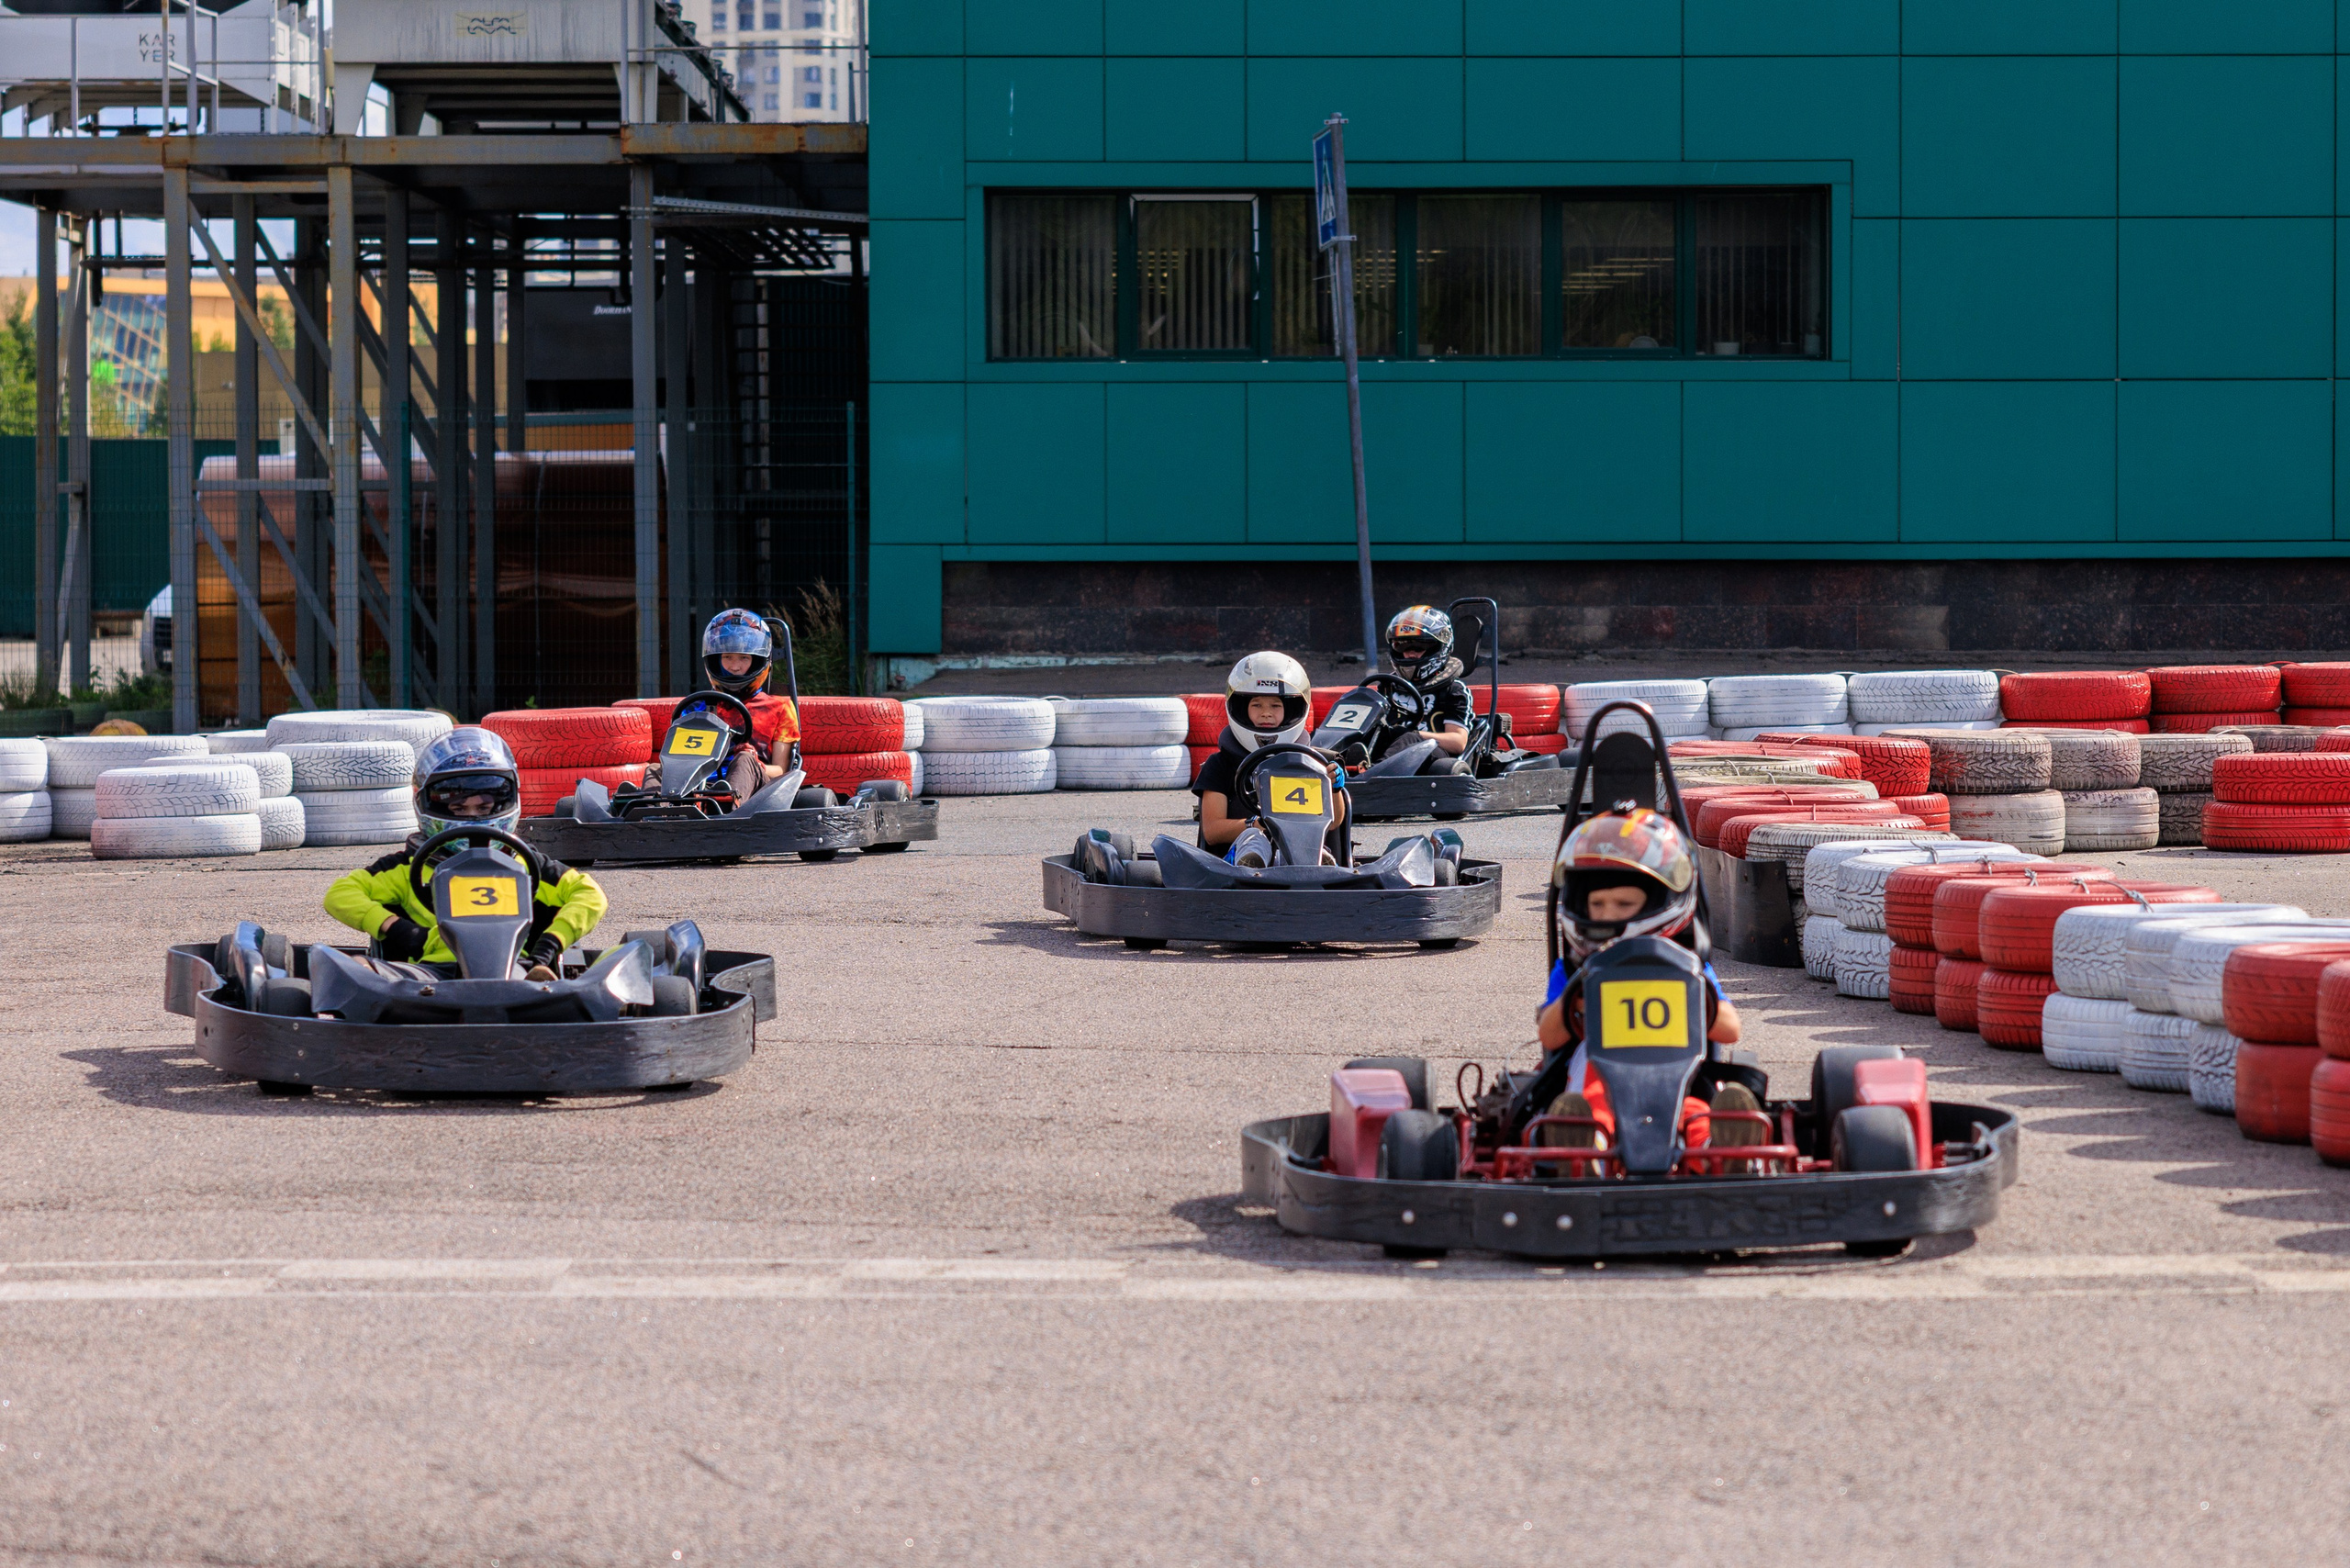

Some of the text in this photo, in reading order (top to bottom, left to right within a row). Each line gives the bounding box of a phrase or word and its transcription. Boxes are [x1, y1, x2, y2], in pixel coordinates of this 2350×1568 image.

[139, 33, 175, 46] KAR
[140, 50, 175, 62] YER
[1338, 710, 1358, 722] 2
[684, 735, 704, 749] 5
[1284, 787, 1309, 806] 4
[470, 886, 498, 905] 3
[1619, 997, 1670, 1029] 10
